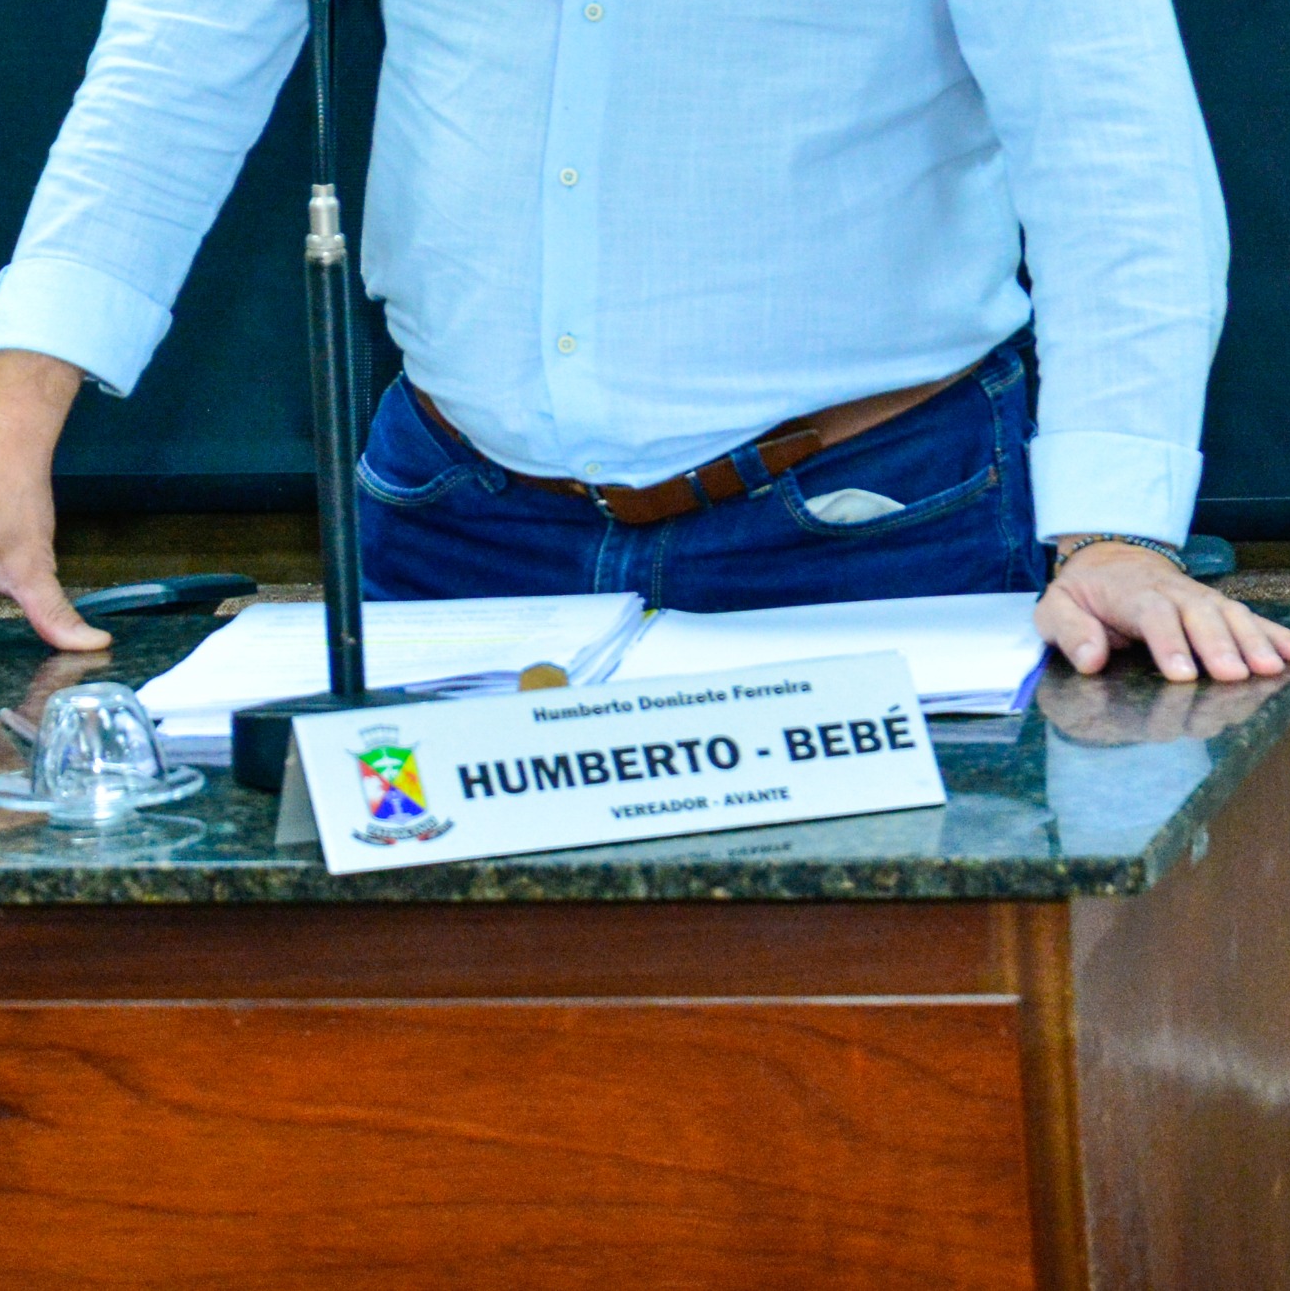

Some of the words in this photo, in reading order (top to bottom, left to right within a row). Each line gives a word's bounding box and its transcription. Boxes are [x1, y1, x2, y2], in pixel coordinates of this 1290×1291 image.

[532, 700, 633, 722] Humberto
[639, 689, 727, 711] Donizete
[732, 680, 813, 699] Ferreira
[458, 735, 741, 799] HUMBERTO
[782, 704, 916, 762] BEBÉ
[611, 795, 708, 819] VEREADOR
[724, 786, 791, 807] AVANTE
